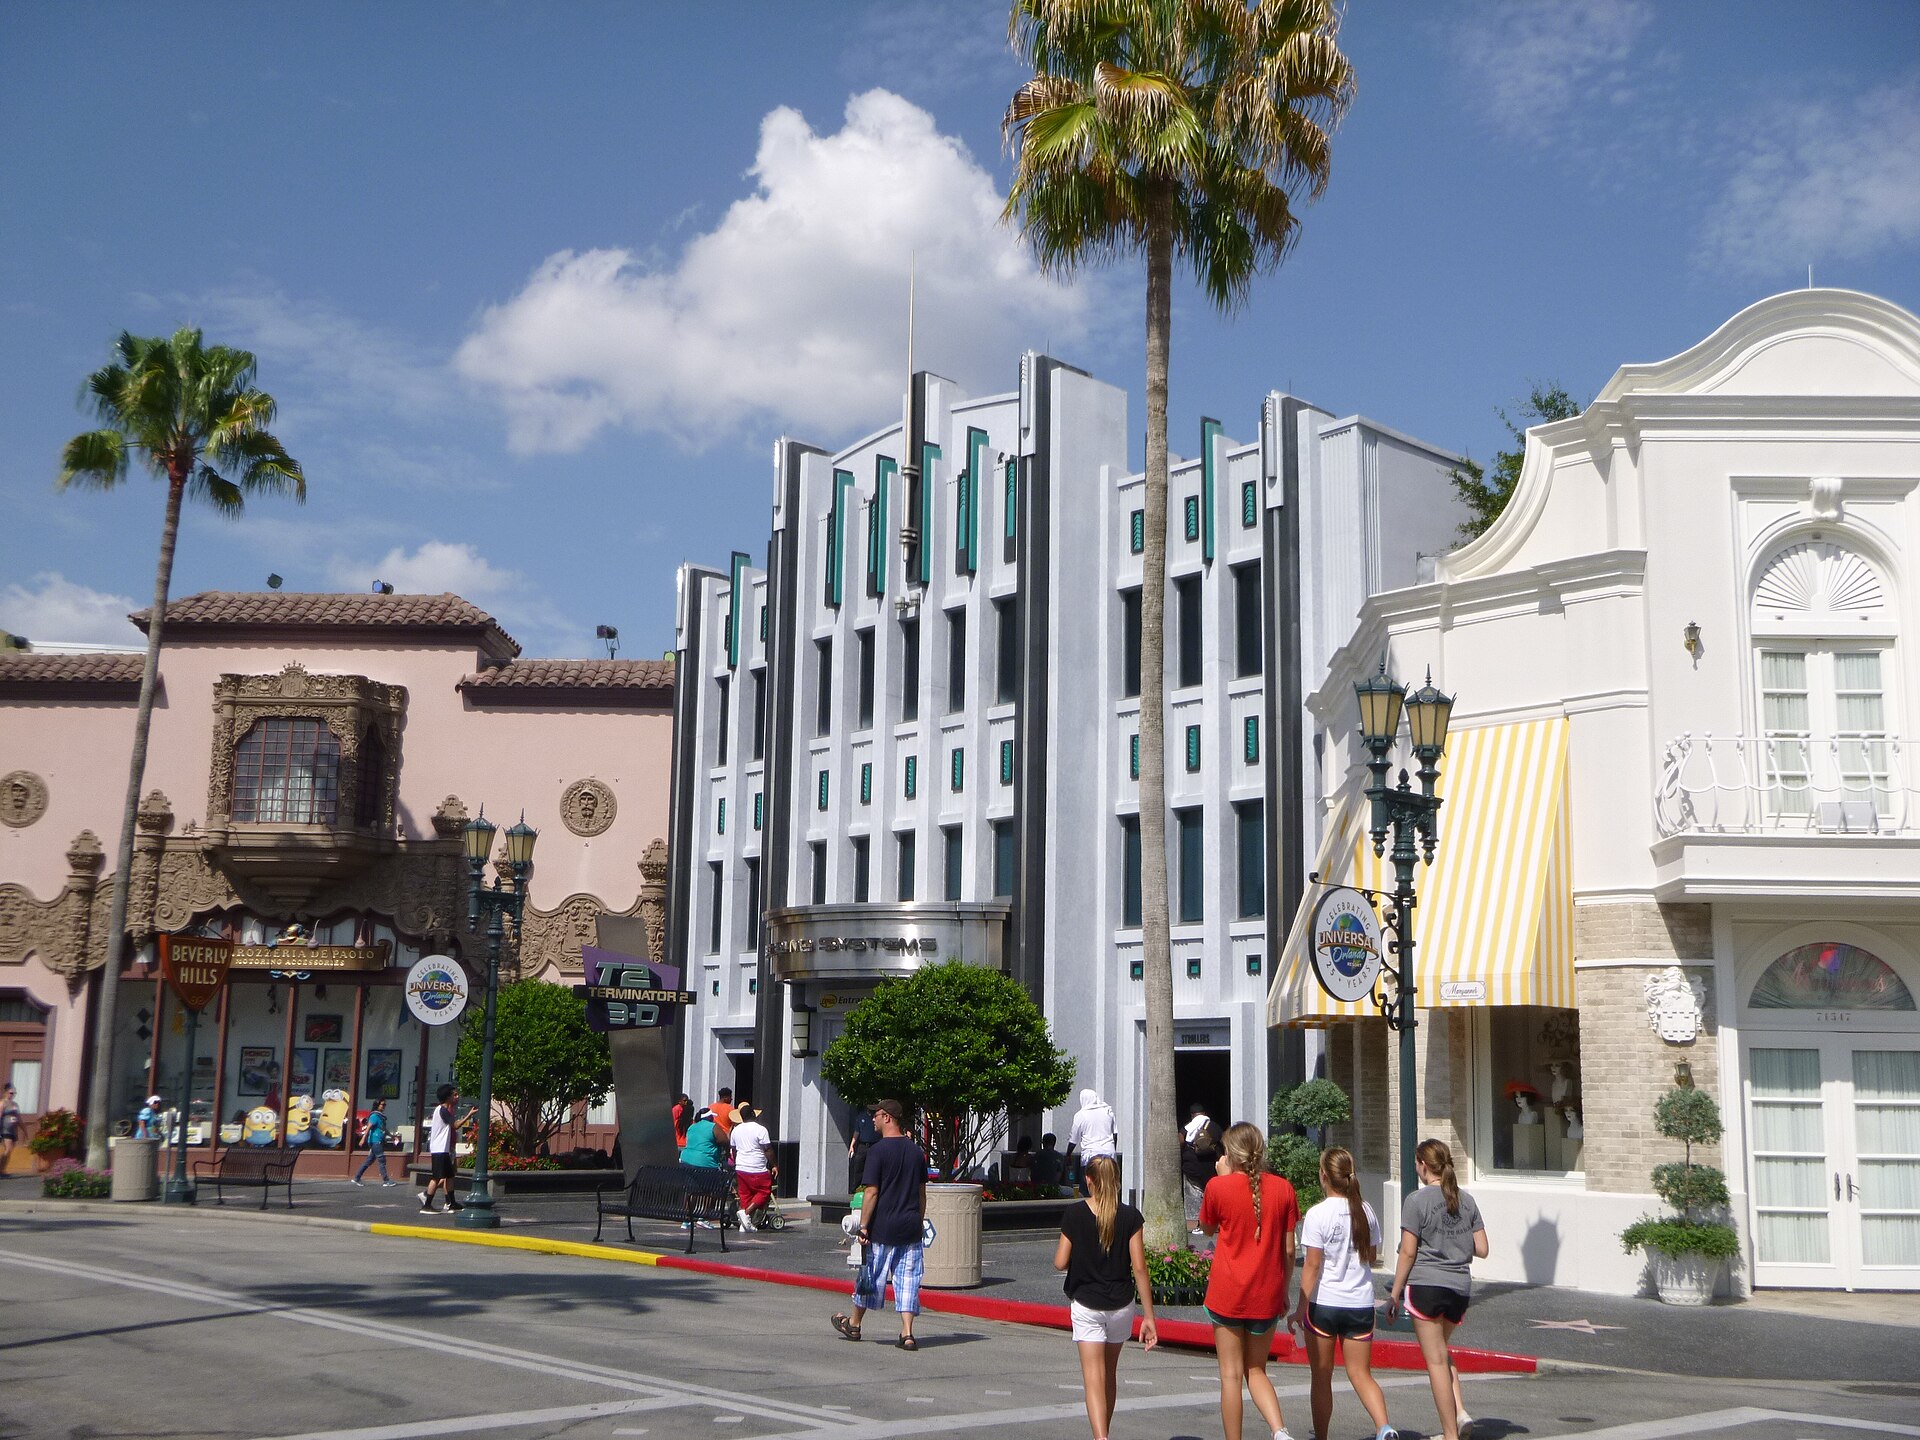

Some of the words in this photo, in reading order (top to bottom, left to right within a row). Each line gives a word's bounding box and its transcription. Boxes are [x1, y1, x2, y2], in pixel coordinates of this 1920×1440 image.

[1326, 901, 1371, 930] CELEBRATING
[818, 937, 938, 957] SYSTEMS
[1318, 930, 1376, 949] UNIVERSAL
[171, 944, 228, 964] BEVERLY
[231, 947, 309, 959] ROZZERIA
[311, 949, 329, 959] DE
[332, 949, 375, 960] PAOLO
[284, 959, 345, 967] ACCESSORIES
[1332, 946, 1366, 963] Orlando
[180, 966, 218, 985] HILLS
[416, 962, 459, 981] CELEBRATING
[595, 961, 651, 989] T2
[1325, 960, 1336, 976] 25
[1347, 964, 1372, 989] YEARS
[410, 981, 463, 993] UNIVERSAL
[421, 990, 453, 1002] Orlando
[589, 987, 677, 1002] TERMINATOR
[679, 992, 689, 1003] 2
[434, 1001, 457, 1017] YEARS
[607, 1002, 660, 1026] 3-D
